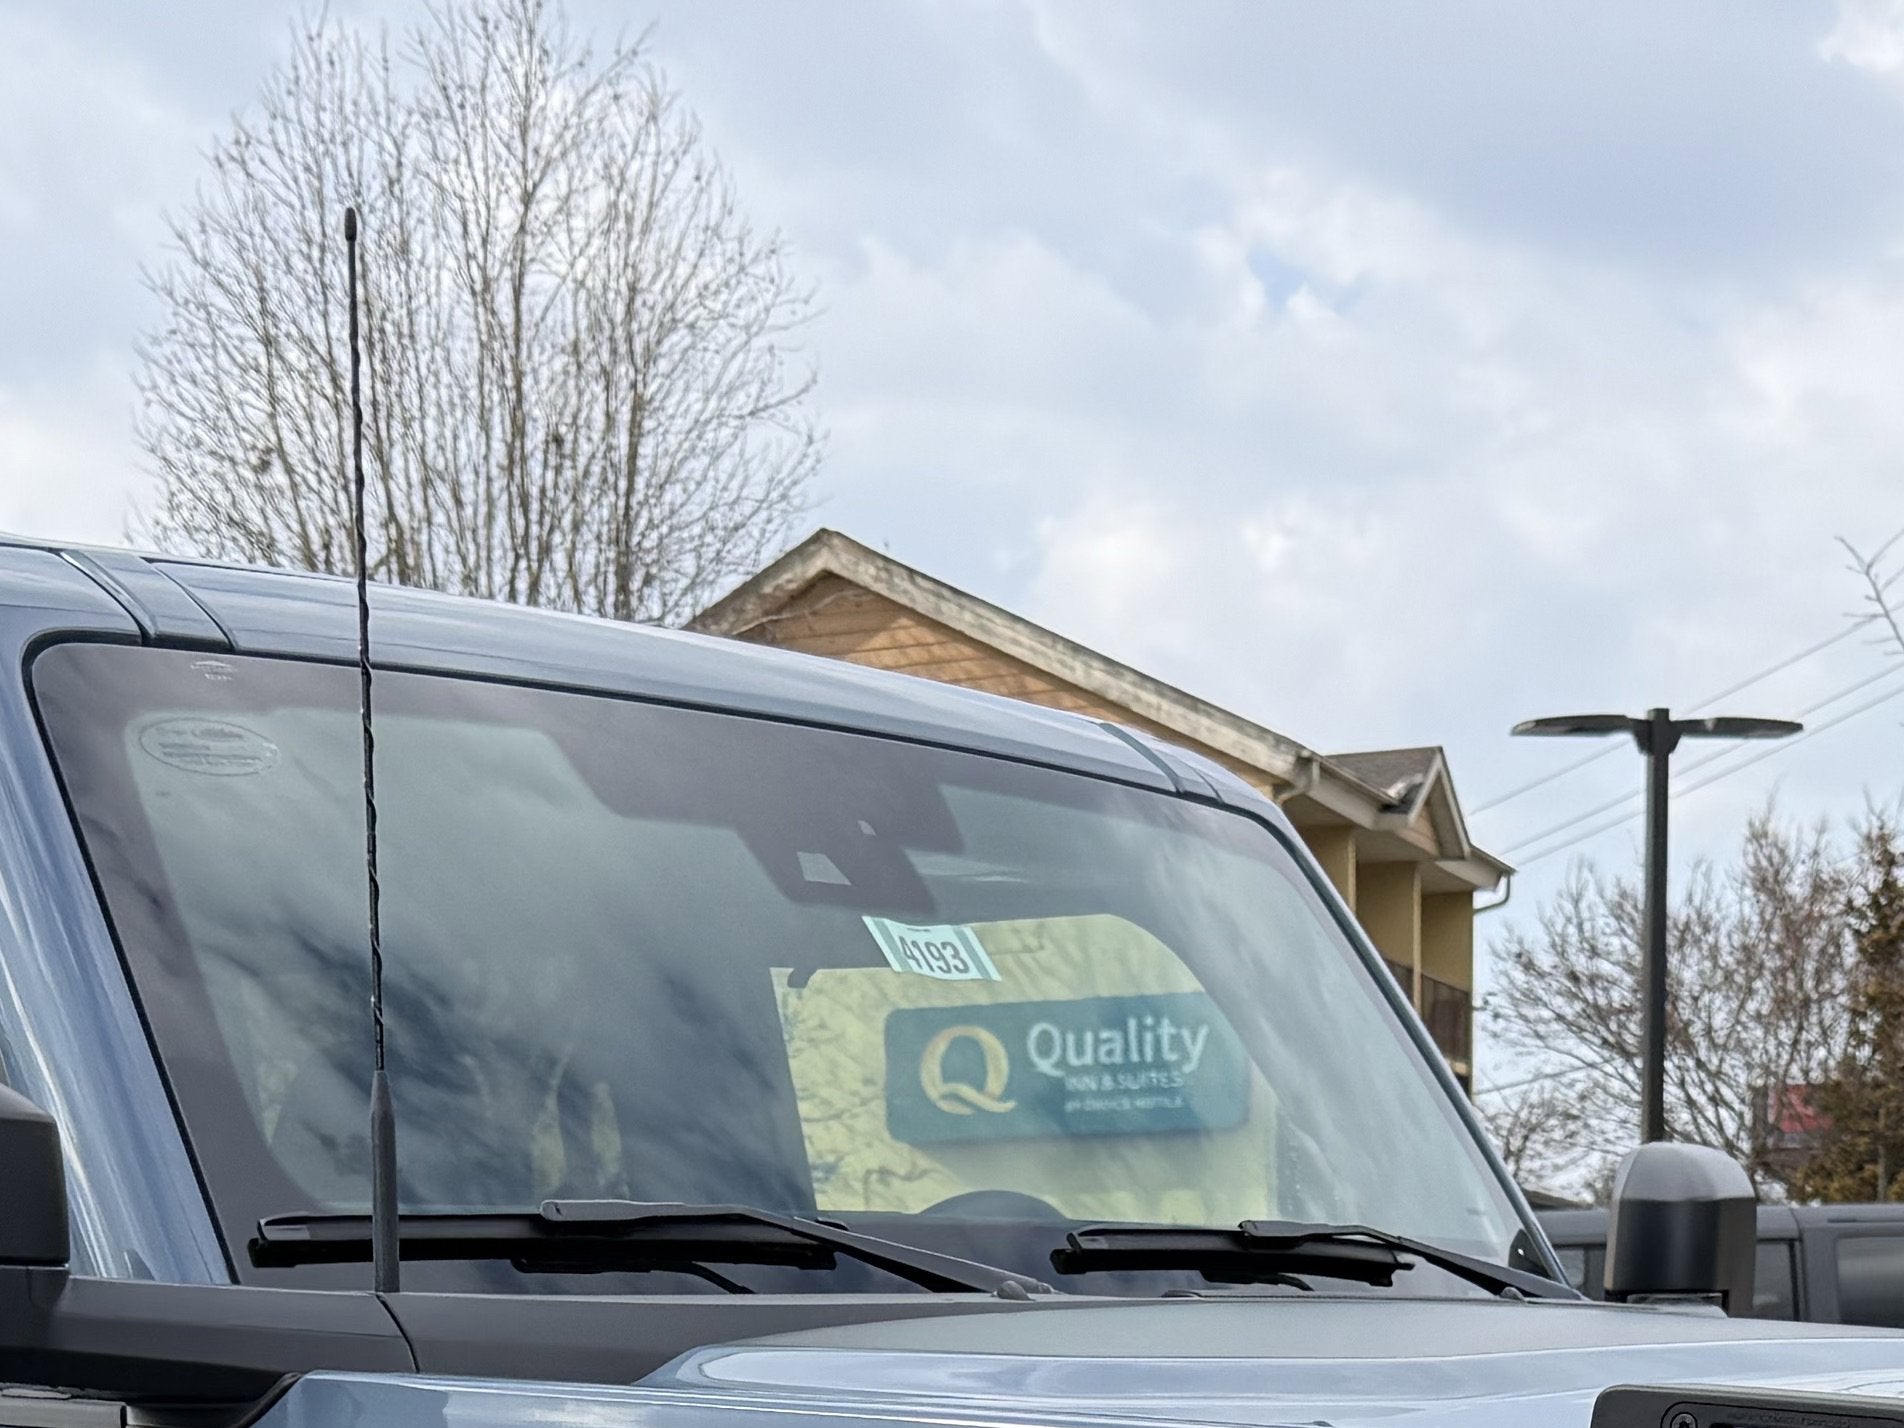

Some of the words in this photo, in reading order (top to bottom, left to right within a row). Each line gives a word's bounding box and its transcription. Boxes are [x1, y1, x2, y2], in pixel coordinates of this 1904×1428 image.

[899, 936, 969, 973] 4193
[921, 1026, 1016, 1114] Q
[1027, 1016, 1209, 1077] Quality
